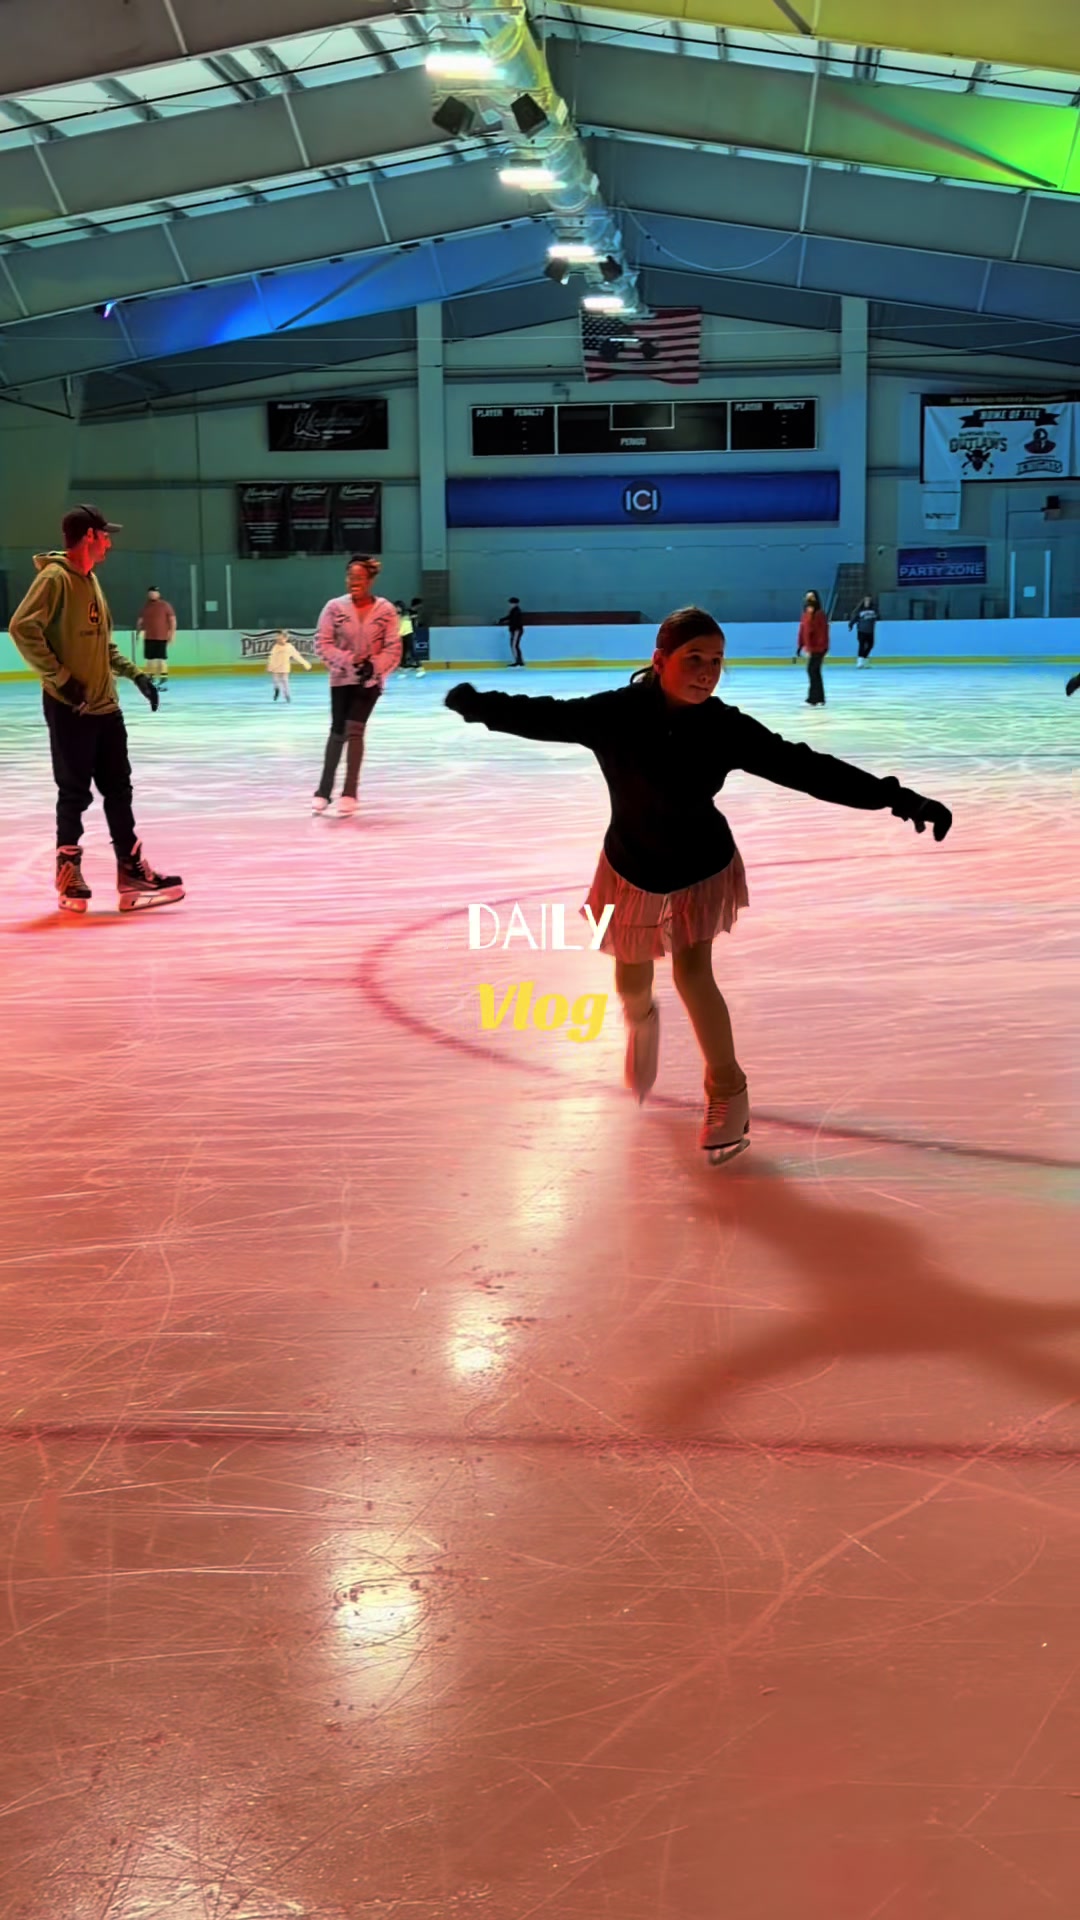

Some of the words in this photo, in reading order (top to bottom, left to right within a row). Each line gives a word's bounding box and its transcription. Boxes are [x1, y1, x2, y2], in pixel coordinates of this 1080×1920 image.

[626, 489, 658, 511] ICI
[900, 566, 943, 577] PARTY
[947, 564, 985, 575] ZONE
[241, 638, 277, 656] Pizz
